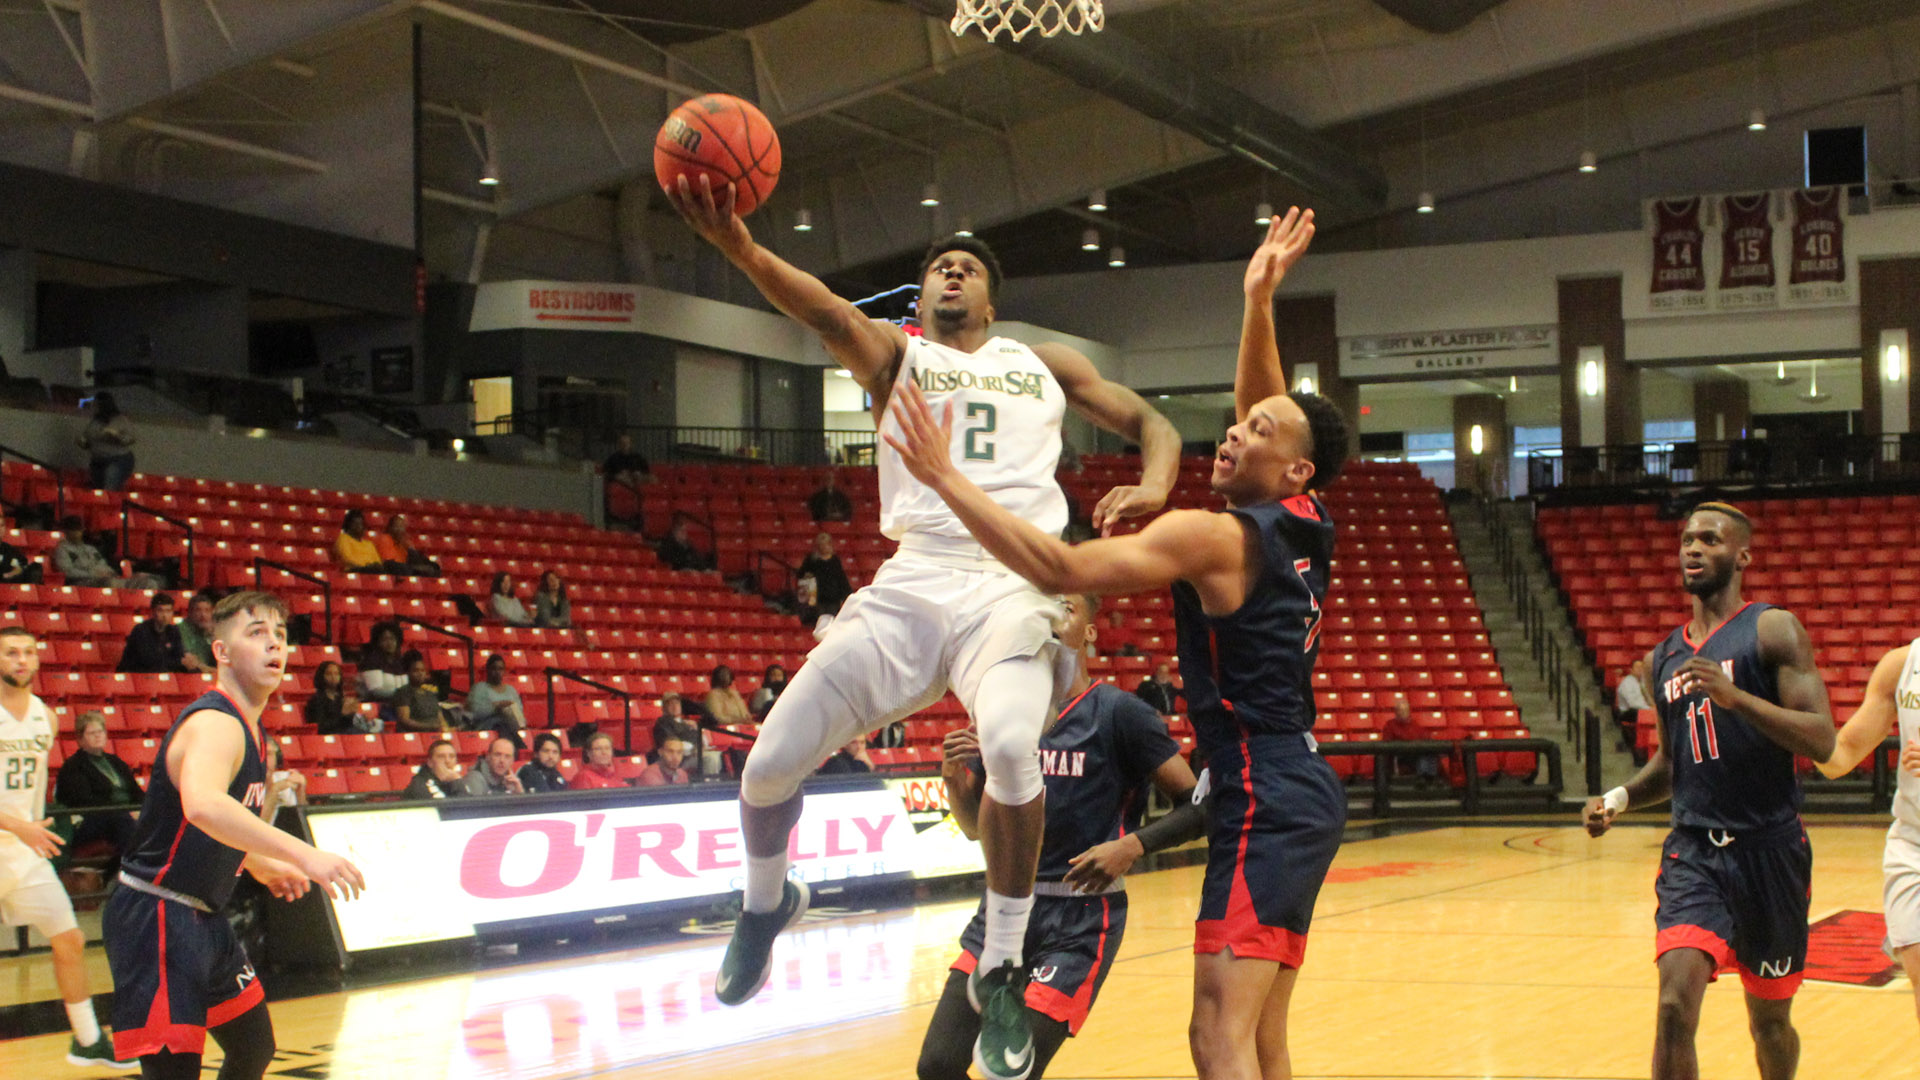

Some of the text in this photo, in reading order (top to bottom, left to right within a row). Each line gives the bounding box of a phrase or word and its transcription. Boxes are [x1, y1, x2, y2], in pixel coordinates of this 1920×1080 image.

[1666, 243, 1693, 266] 44
[1738, 239, 1761, 262] 15
[1805, 234, 1832, 256] 40
[529, 289, 635, 312] RESTROOMS
[1431, 331, 1496, 347] PLASTER
[1415, 356, 1485, 369] GALLERY
[964, 401, 997, 462] 2
[1686, 697, 1720, 764] 11
[6, 757, 36, 790] 22
[1038, 749, 1087, 777] MAN
[459, 813, 896, 900] O'RELLY
[729, 860, 886, 892] CNTER
